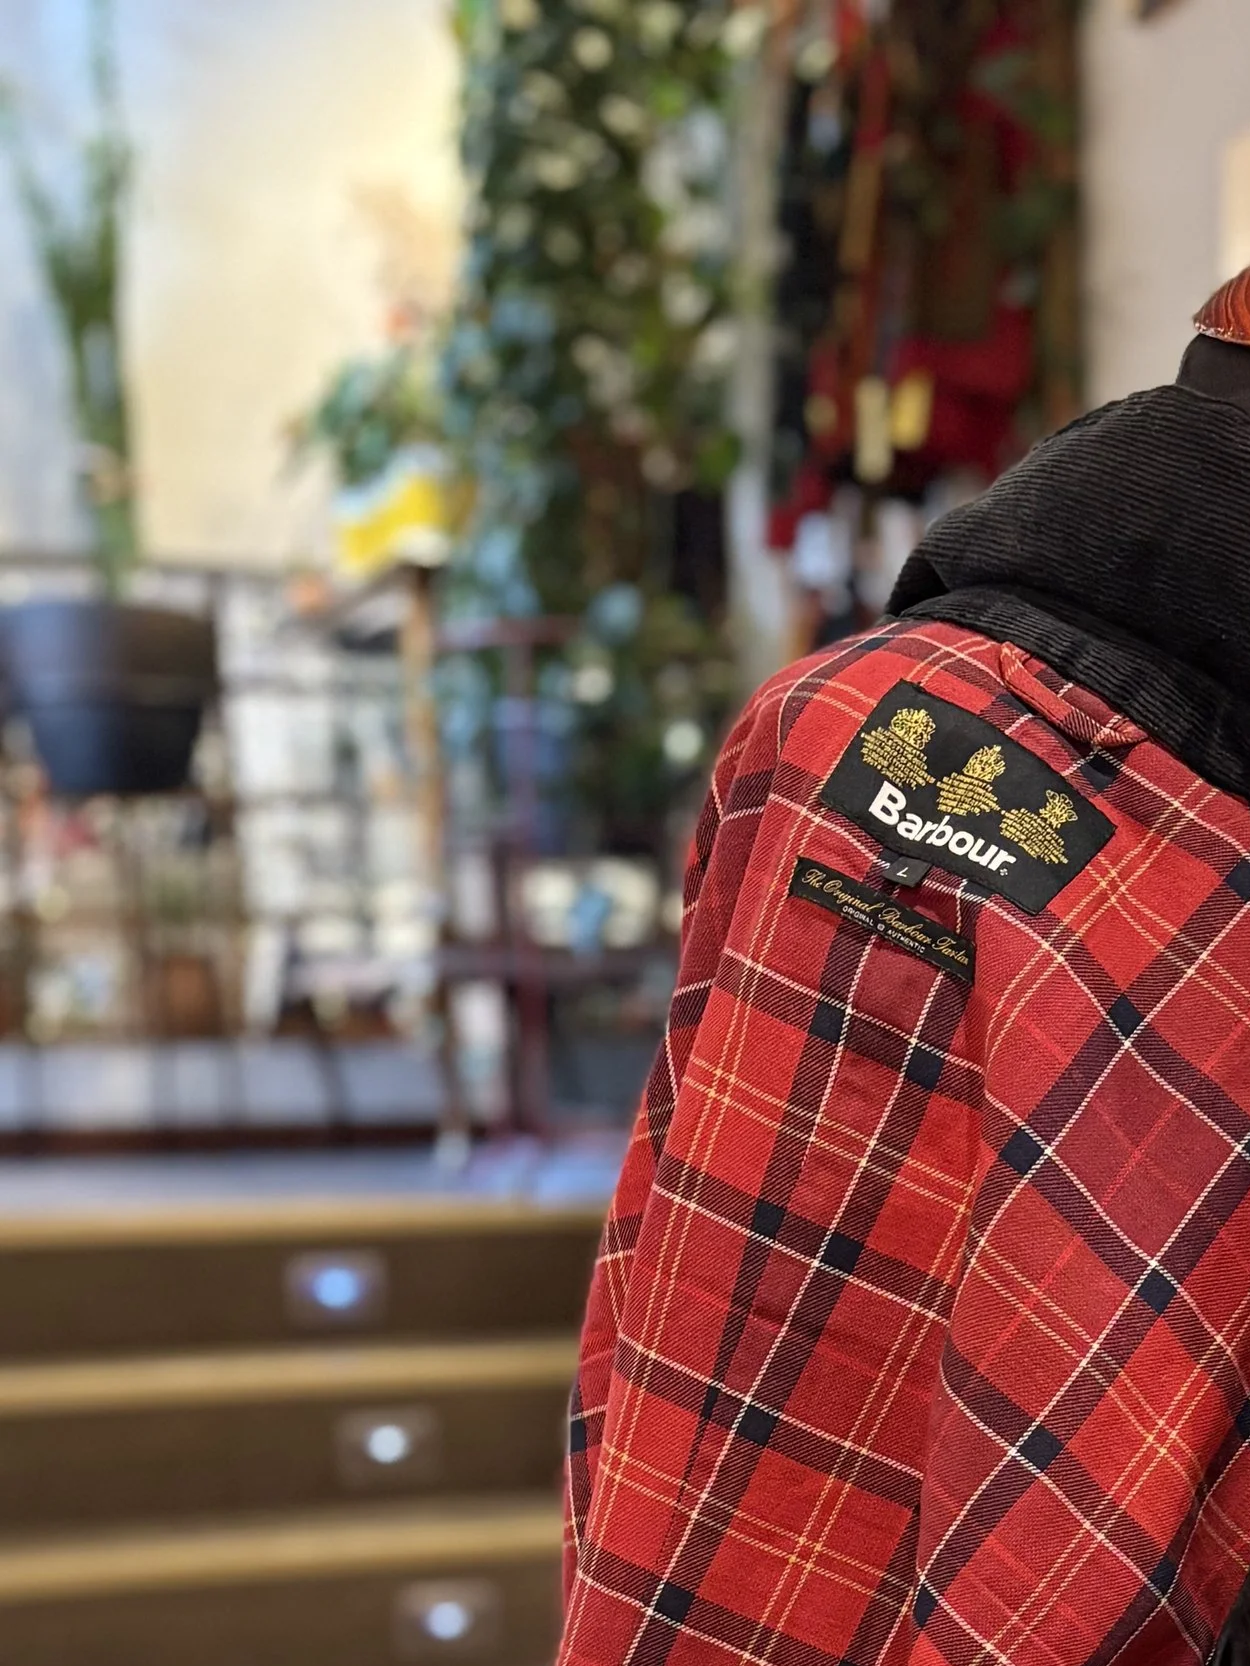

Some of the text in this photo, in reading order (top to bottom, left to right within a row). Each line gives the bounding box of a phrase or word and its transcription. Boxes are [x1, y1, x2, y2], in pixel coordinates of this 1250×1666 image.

[868, 780, 1017, 871] Barbour
[801, 869, 969, 965] The Original Barbour Tartan
[842, 905, 874, 926] ORIGINAL
[887, 929, 926, 954] AUTHENTIC
